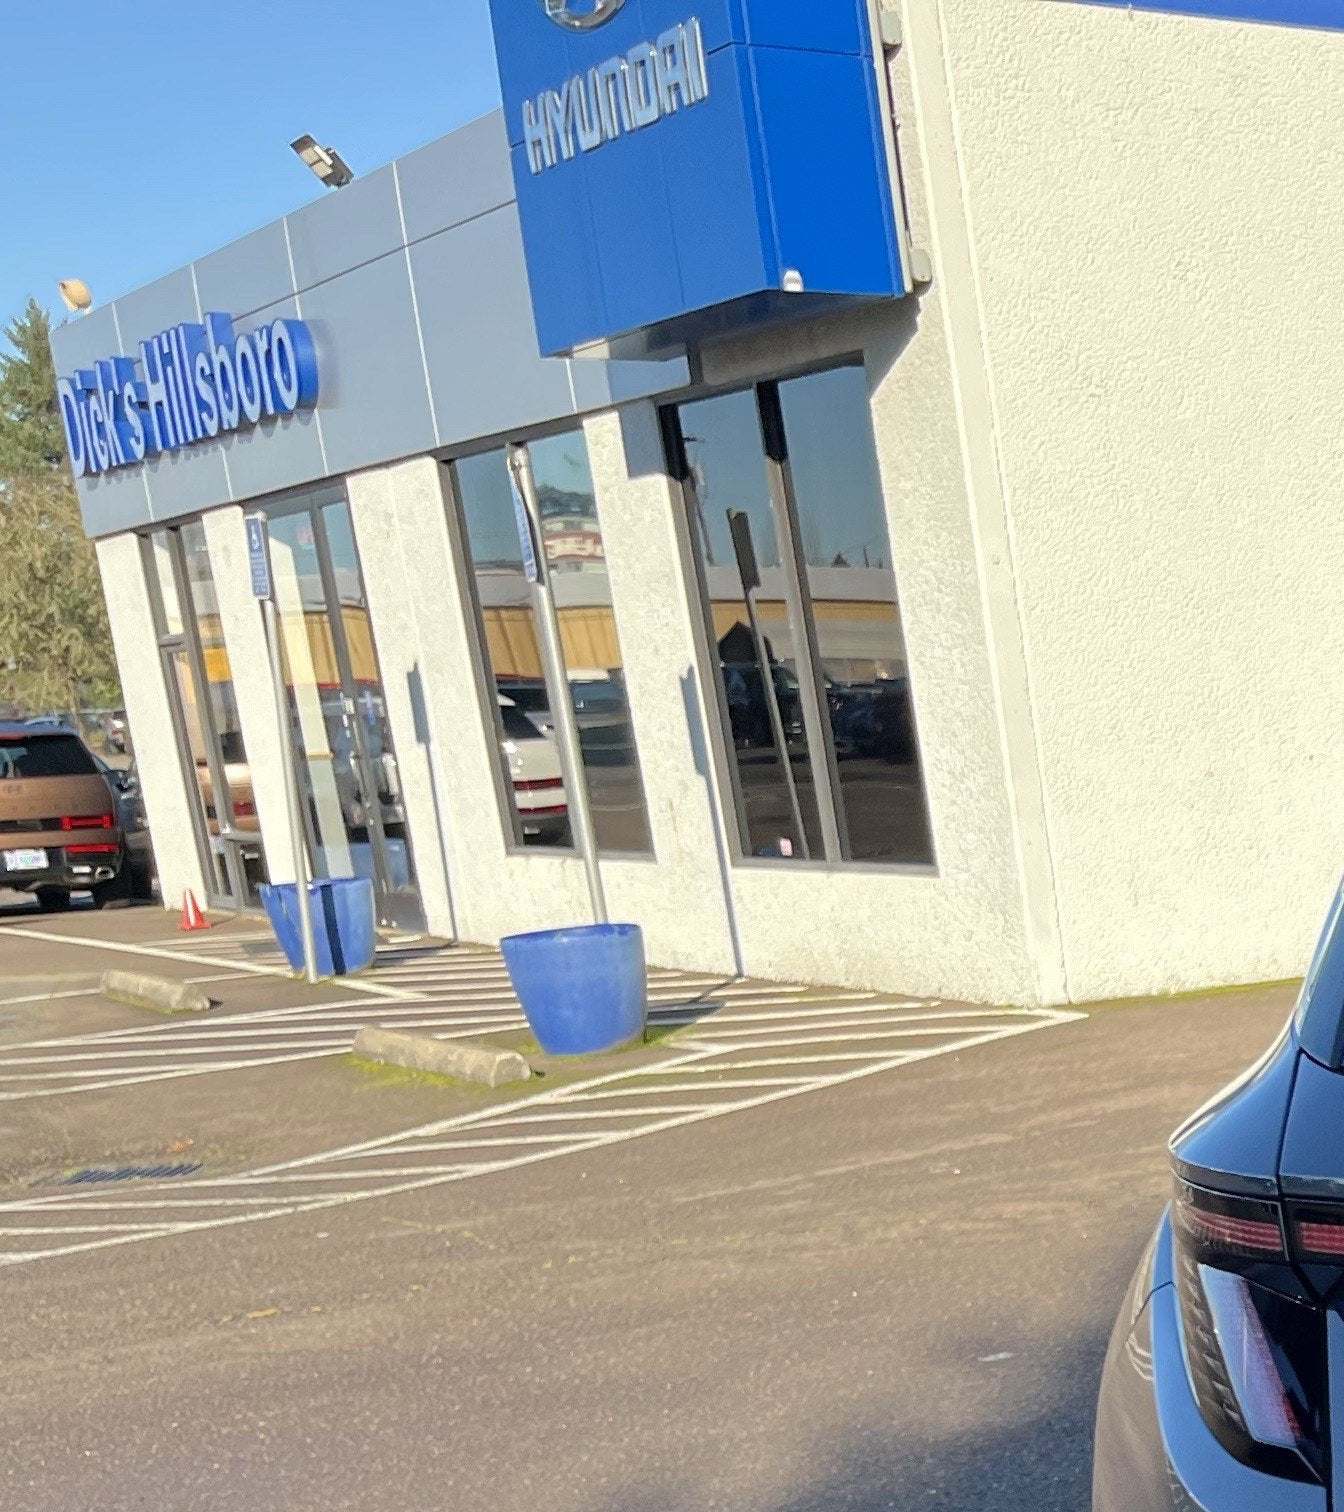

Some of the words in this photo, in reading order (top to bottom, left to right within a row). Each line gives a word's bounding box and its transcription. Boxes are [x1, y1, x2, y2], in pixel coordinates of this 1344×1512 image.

[522, 16, 708, 176] HYUNDAI
[57, 358, 146, 477] Dick's
[140, 313, 303, 451] Hillsboro
